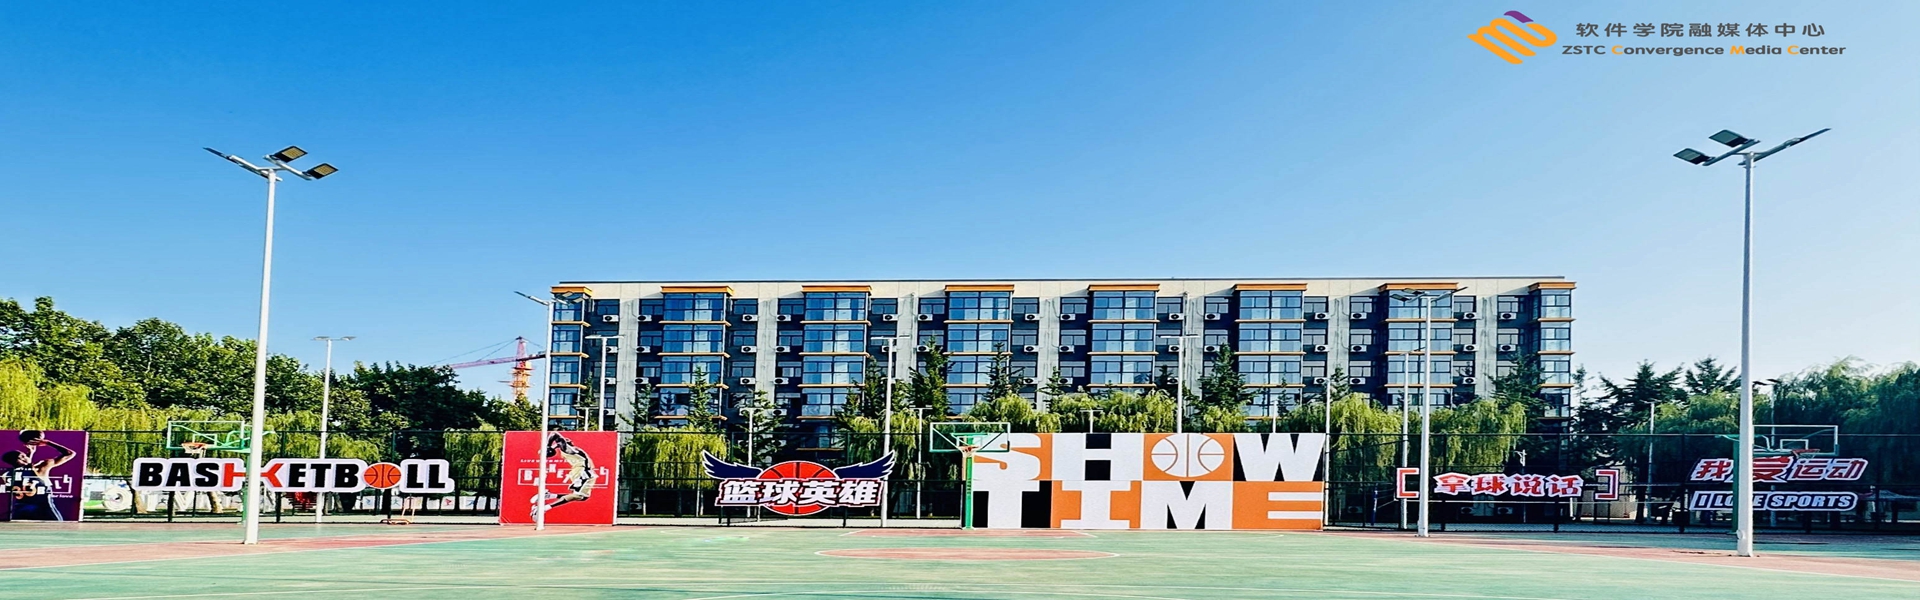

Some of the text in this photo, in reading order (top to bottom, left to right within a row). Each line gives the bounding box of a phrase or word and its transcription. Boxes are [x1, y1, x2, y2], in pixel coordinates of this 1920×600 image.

[138, 462, 447, 489] BASKETBLL
[1436, 474, 1581, 495] 拿球说话
[719, 480, 879, 505] 篮球英雄
[972, 480, 1324, 530] TIME
[1714, 495, 1764, 507] LOE
[1770, 494, 1852, 507] SPORTS
